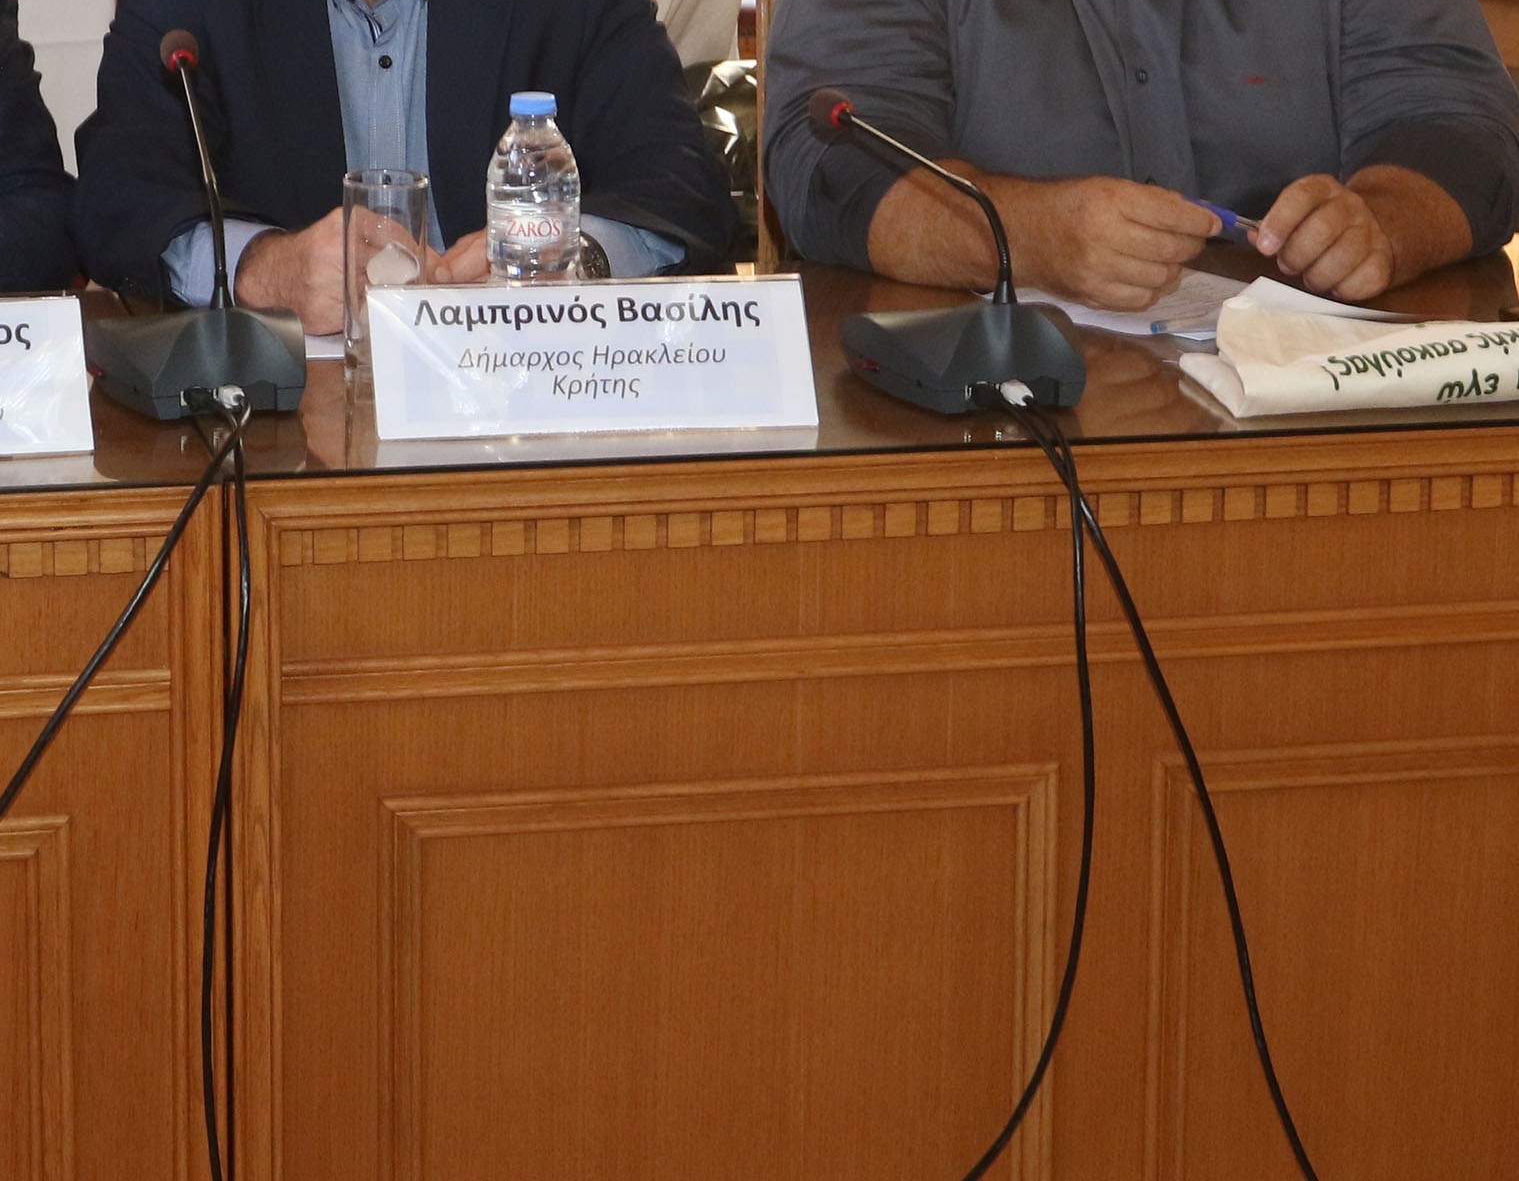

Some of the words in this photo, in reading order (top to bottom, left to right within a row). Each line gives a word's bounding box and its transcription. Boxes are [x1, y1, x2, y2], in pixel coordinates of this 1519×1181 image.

[413, 295, 607, 332] Λαμπρινός
[616, 293, 761, 328] Βασίλης
[457, 346, 585, 374] Δήμαρχος
[592, 341, 726, 371] Ηρακλείου
[552, 372, 641, 401] Κρήτης
